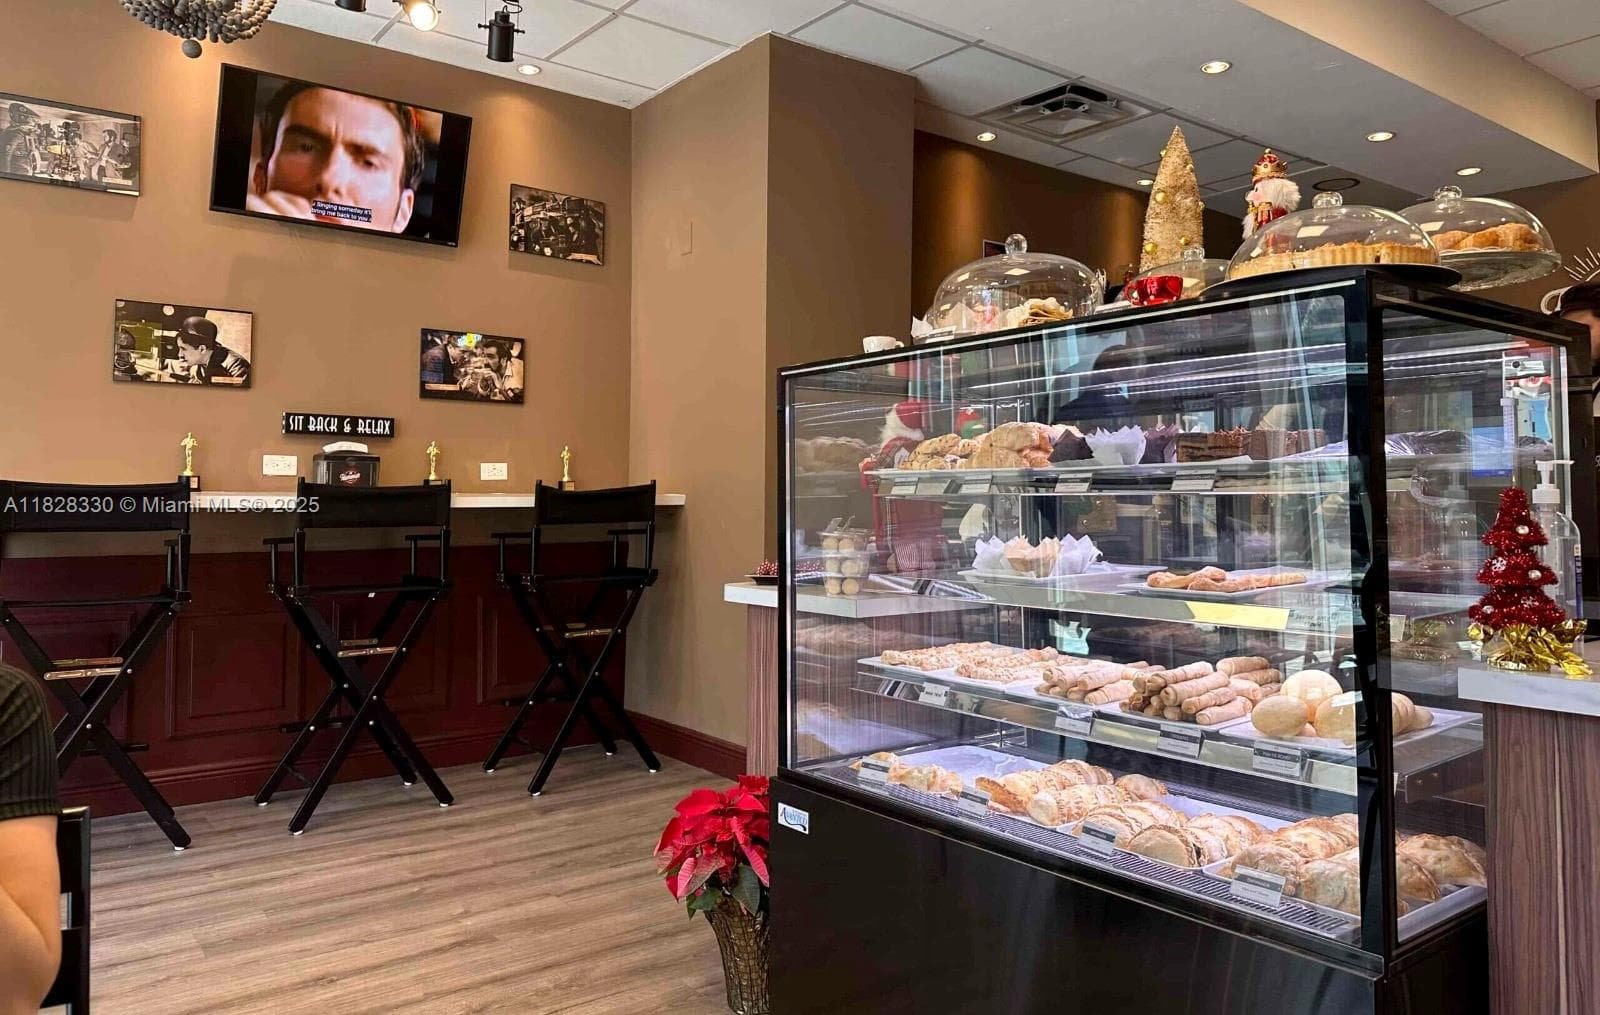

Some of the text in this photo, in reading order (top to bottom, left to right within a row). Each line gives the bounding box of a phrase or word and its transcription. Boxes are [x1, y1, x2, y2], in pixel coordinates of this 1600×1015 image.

[311, 207, 326, 216] bring
[337, 211, 350, 219] back
[338, 206, 363, 215] someday
[289, 415, 391, 435] SIT BACK & RELAX
